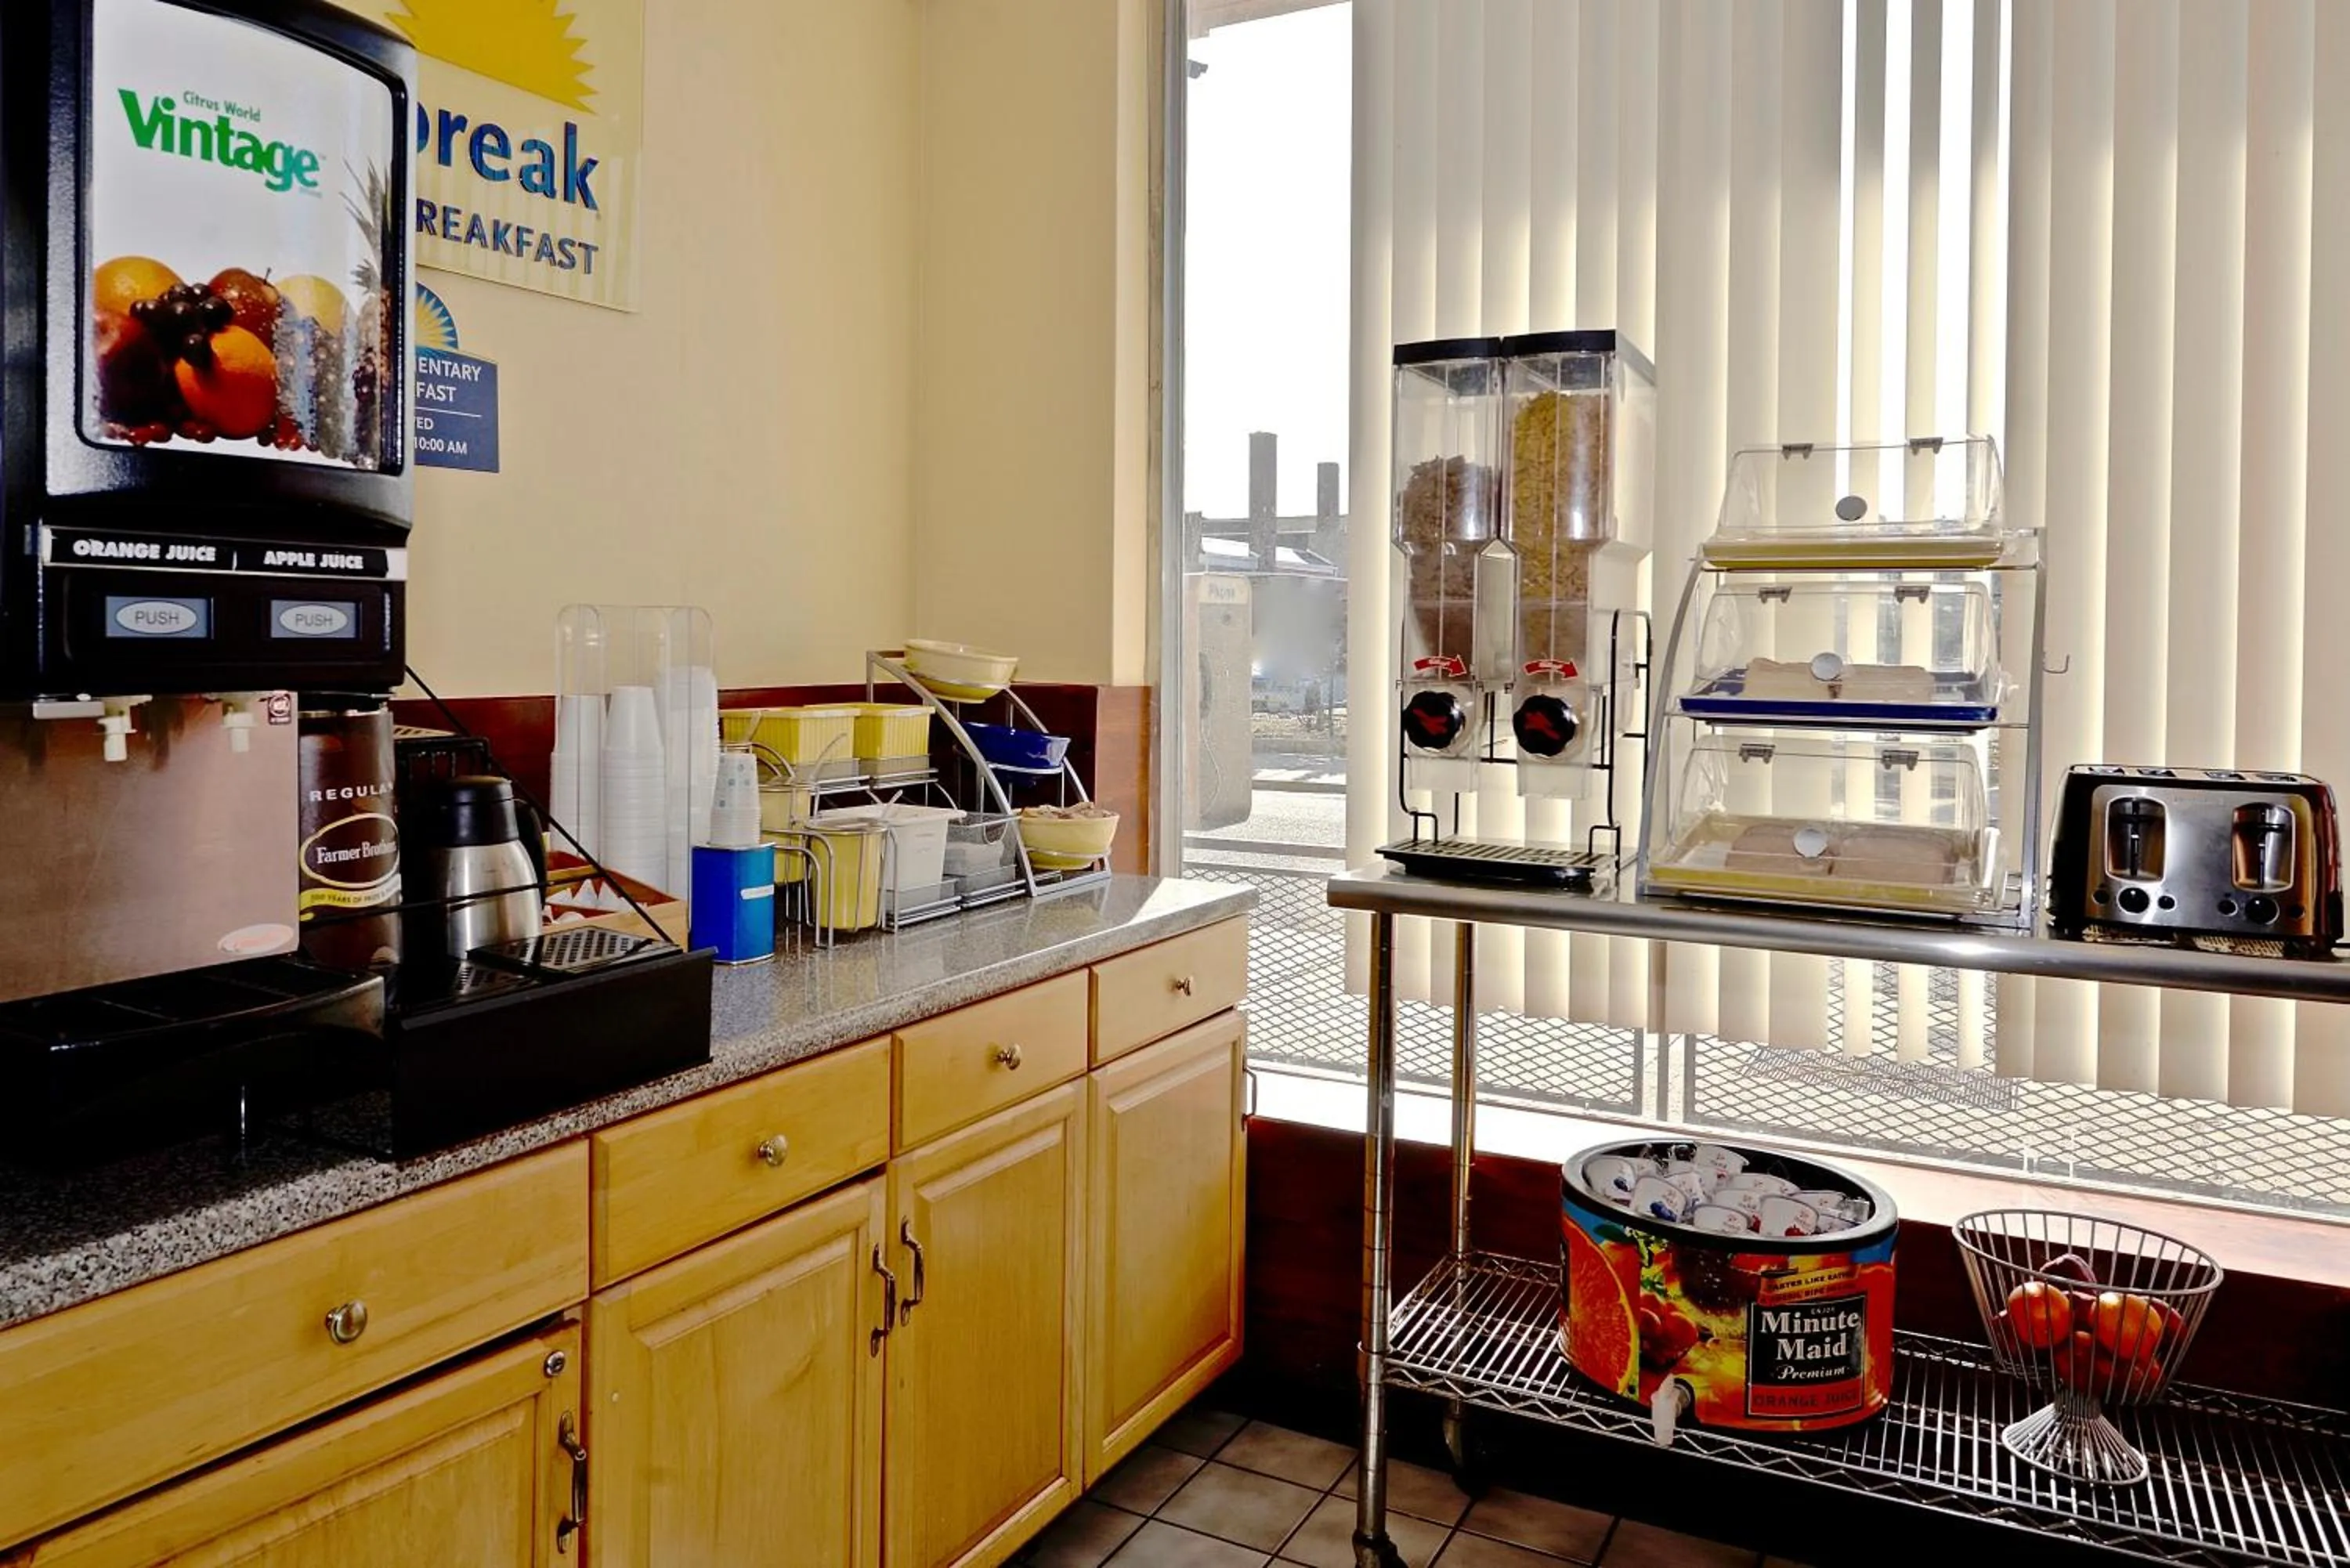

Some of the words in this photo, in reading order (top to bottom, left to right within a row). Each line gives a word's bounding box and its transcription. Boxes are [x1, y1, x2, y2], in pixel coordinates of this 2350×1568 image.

[183, 91, 219, 110] Citrus
[224, 100, 261, 122] World
[118, 88, 320, 192] Vintage
[416, 381, 457, 402] FAST
[414, 416, 434, 430] ED
[447, 440, 468, 454] AM
[73, 540, 161, 560] ORANGE
[165, 544, 216, 562] JUICE
[263, 551, 315, 567] APPLE
[319, 553, 363, 569] JUICE
[134, 610, 180, 626] PUSH
[295, 612, 334, 627] PUSH
[316, 846, 361, 865] Farmer
[1761, 1310, 1860, 1333] Minute
[1776, 1333, 1847, 1360] Maid
[1777, 1364, 1846, 1380] Premium
[1755, 1393, 1817, 1407] ORANGE
